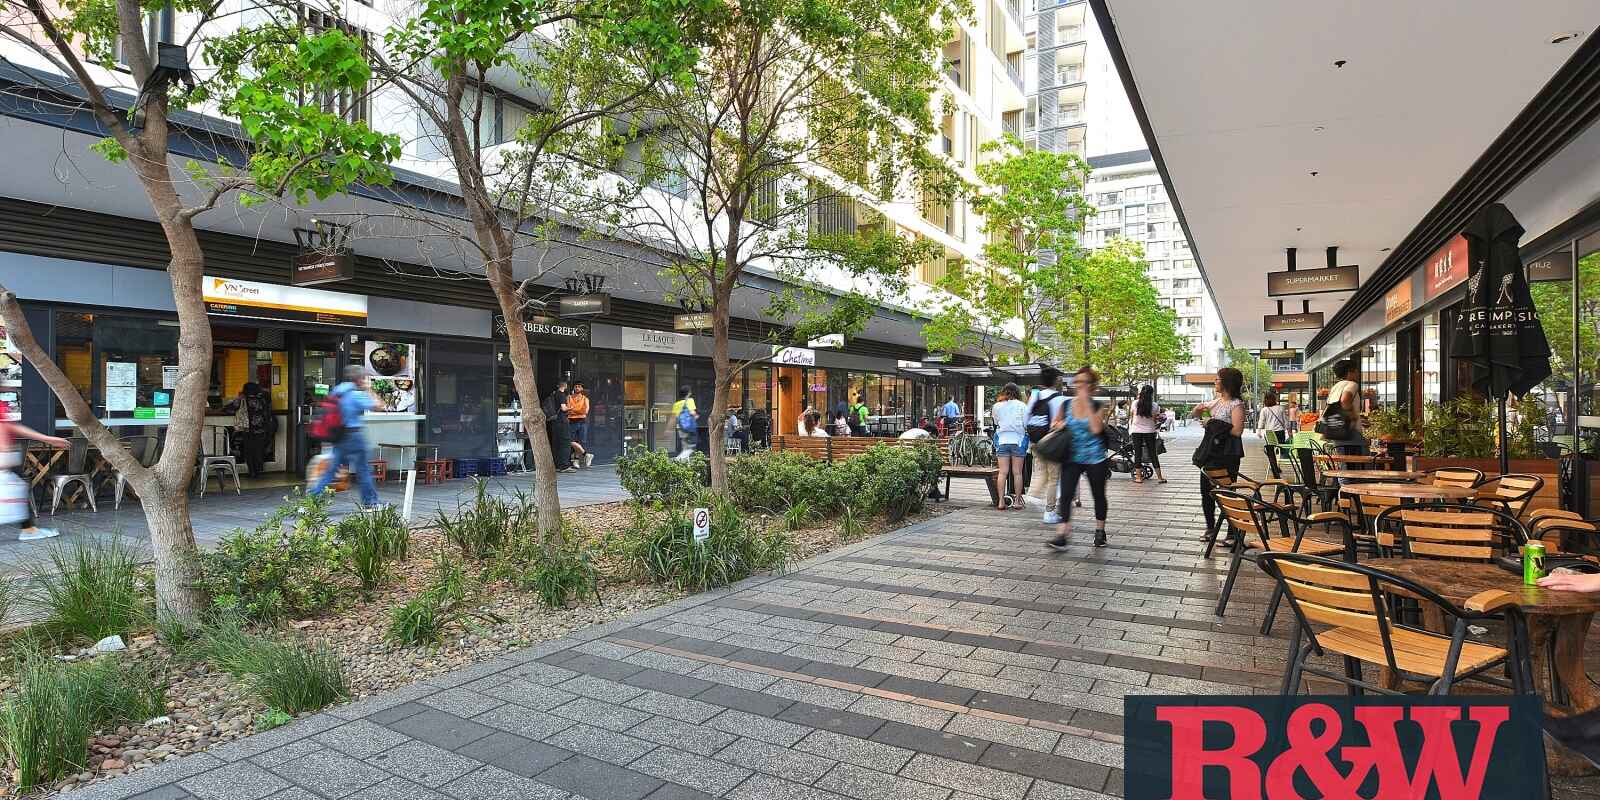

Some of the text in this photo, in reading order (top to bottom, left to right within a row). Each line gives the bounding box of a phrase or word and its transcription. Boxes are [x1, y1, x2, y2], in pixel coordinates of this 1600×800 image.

[1286, 274, 1338, 284] SUPERMARKET
[522, 322, 579, 337] RBERS CREEK
[782, 350, 813, 364] Chatime
